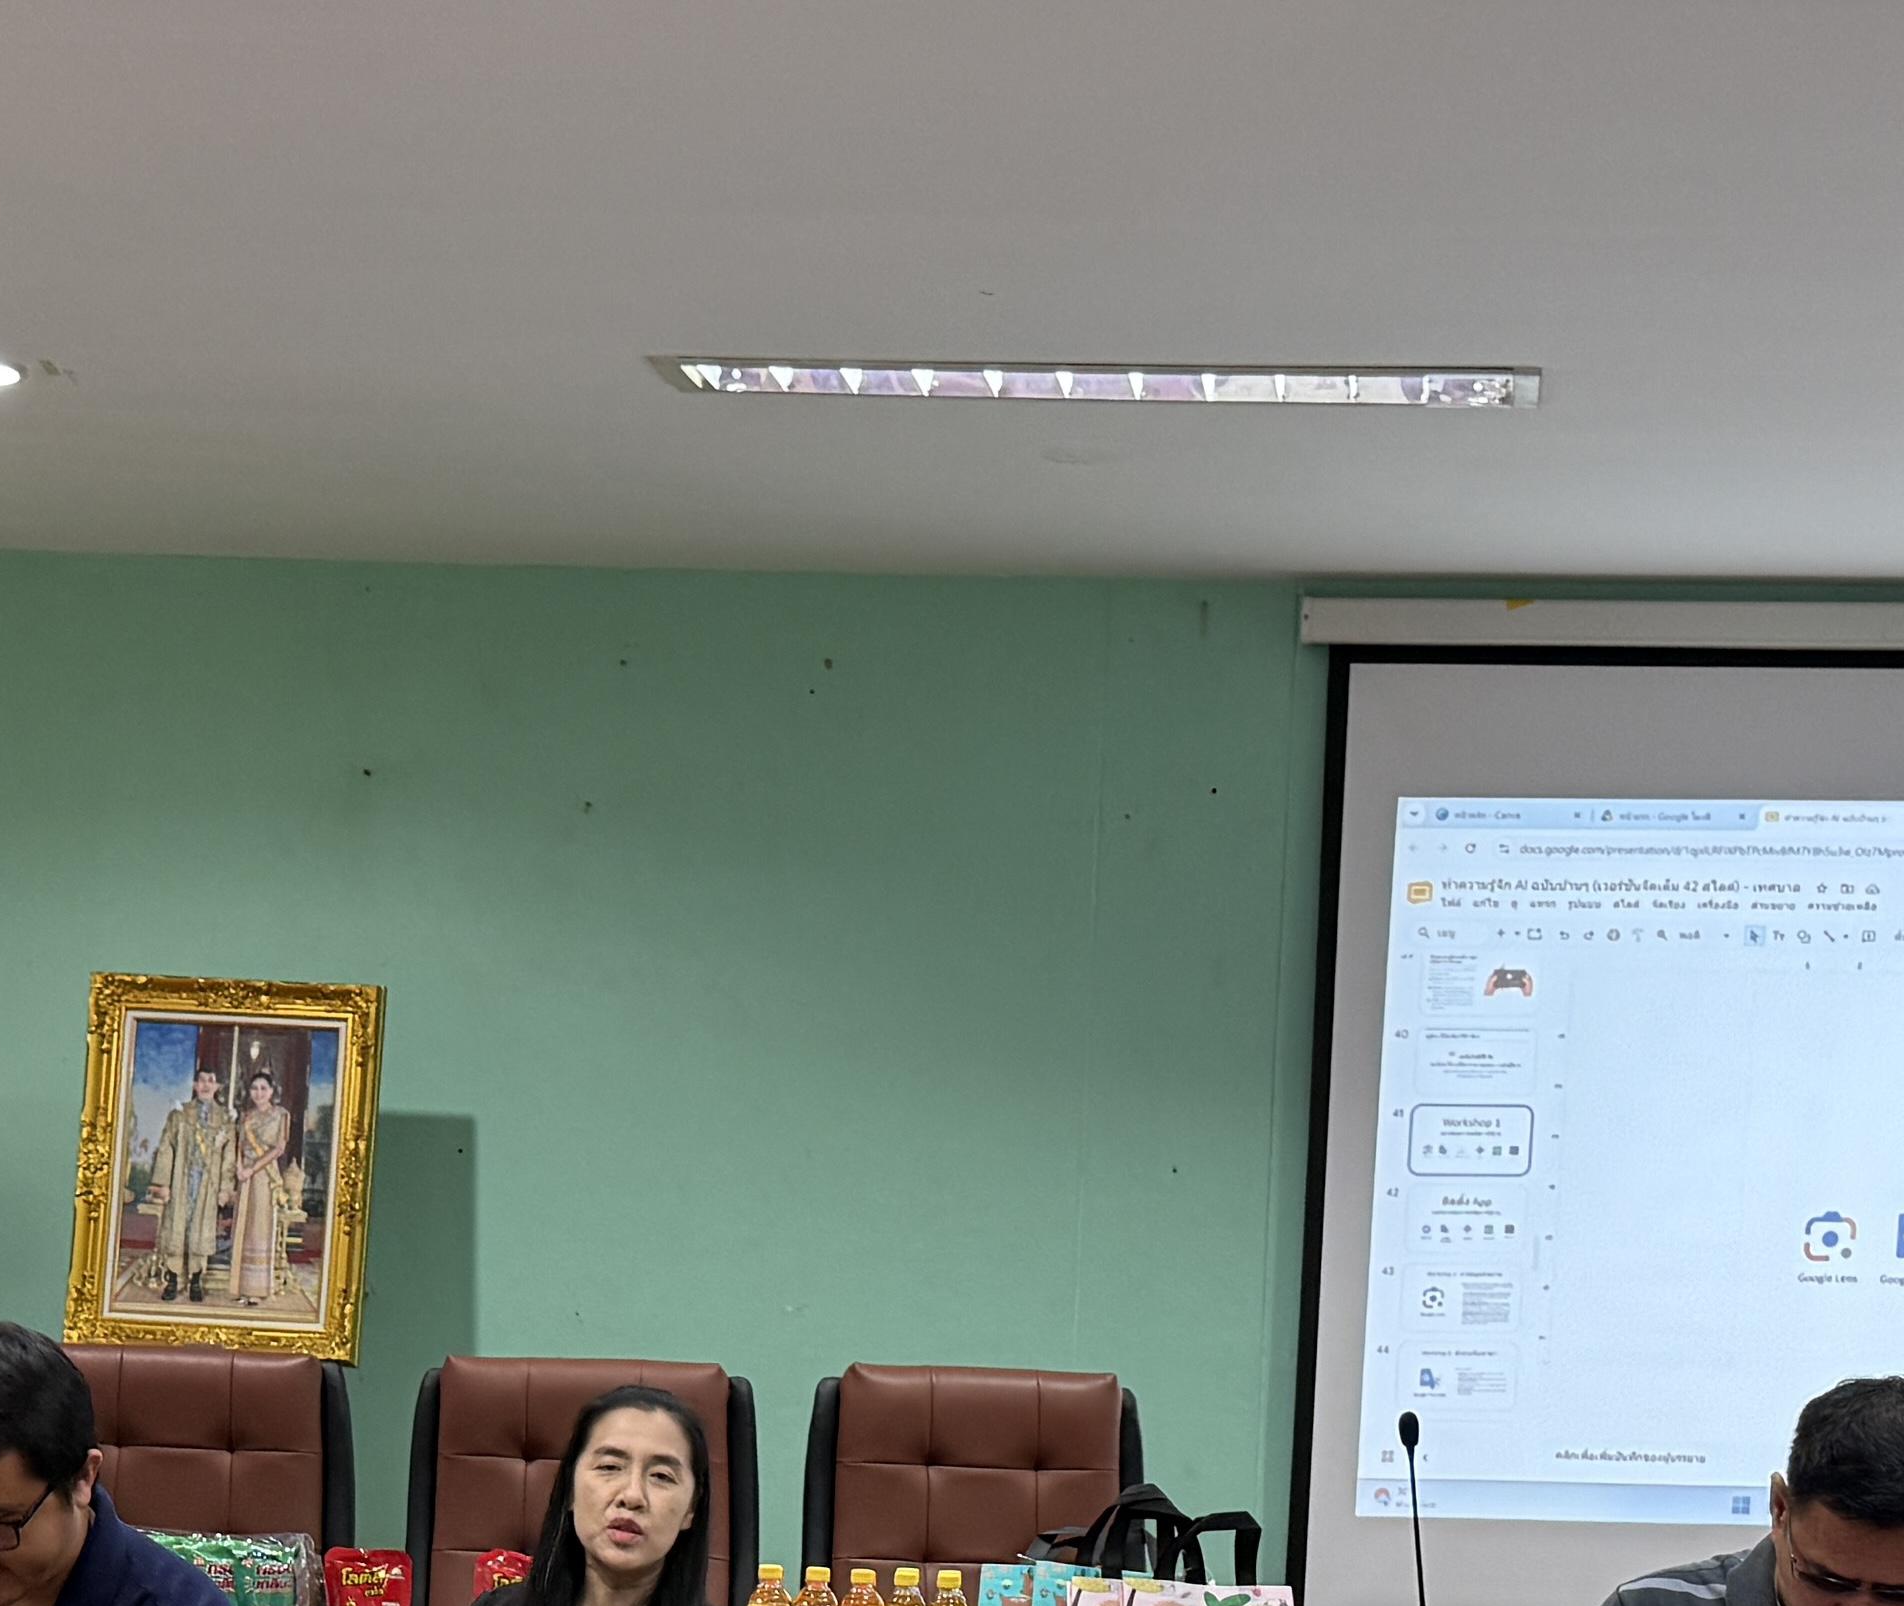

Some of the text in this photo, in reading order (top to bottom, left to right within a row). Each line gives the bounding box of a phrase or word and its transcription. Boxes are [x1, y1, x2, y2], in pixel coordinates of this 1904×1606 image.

[1395, 1029, 1409, 1039] 40
[1442, 1118, 1492, 1129] Workshop
[1473, 1198, 1492, 1208] App
[1798, 1273, 1858, 1285] Google Lens
